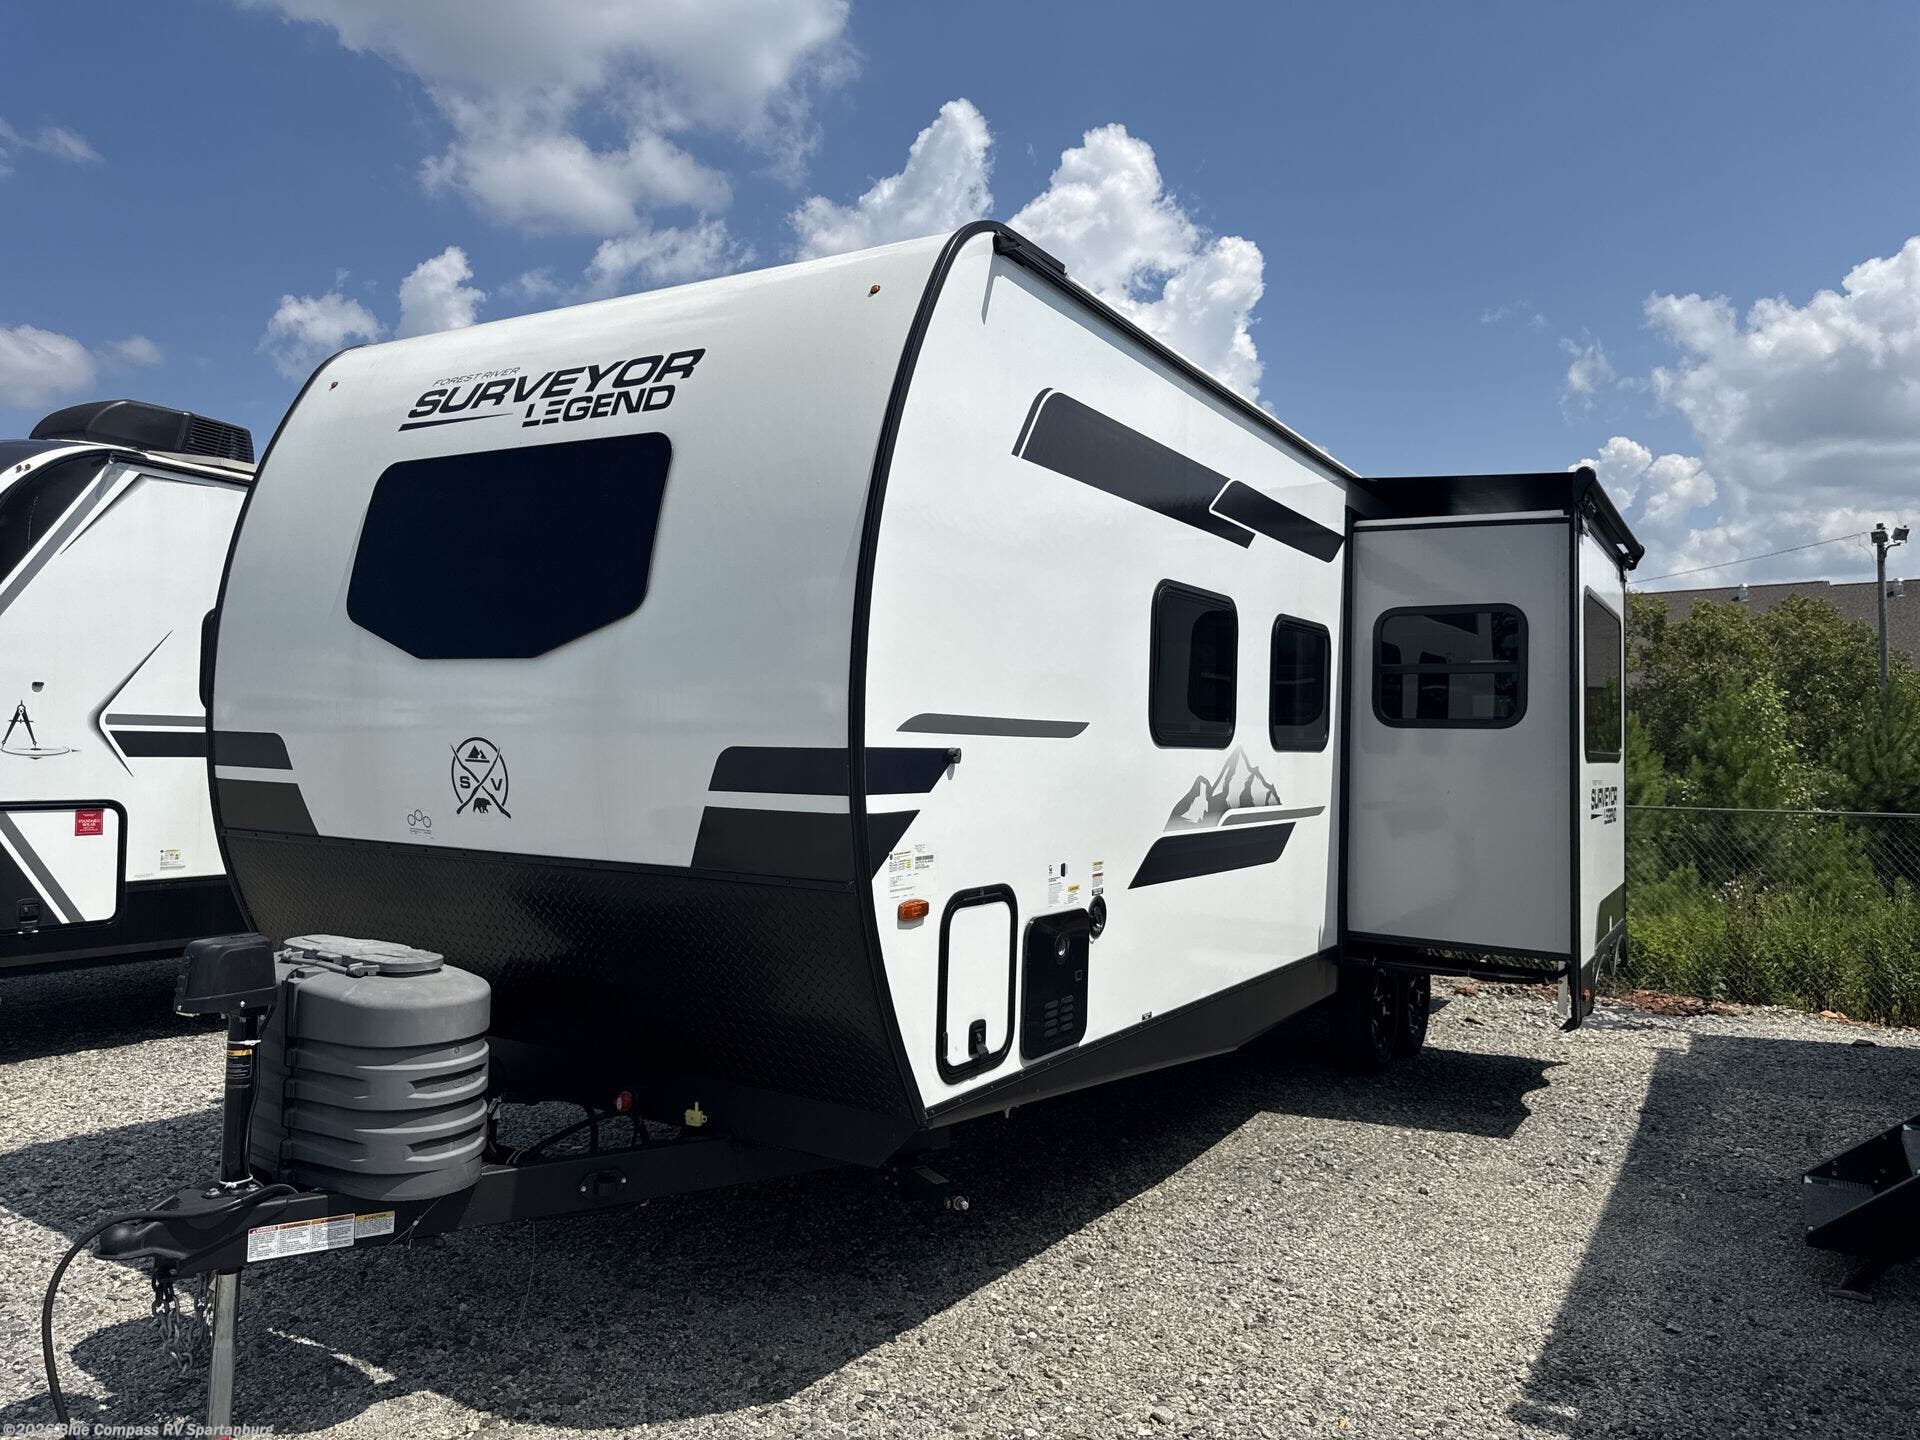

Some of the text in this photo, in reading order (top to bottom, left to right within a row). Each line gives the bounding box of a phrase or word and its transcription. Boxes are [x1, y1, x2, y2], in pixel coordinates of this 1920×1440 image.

[407, 348, 706, 419] SURVEYOR
[432, 366, 521, 387] FOREST RIVER
[521, 384, 676, 428] LEGEND
[459, 775, 503, 791] S V
